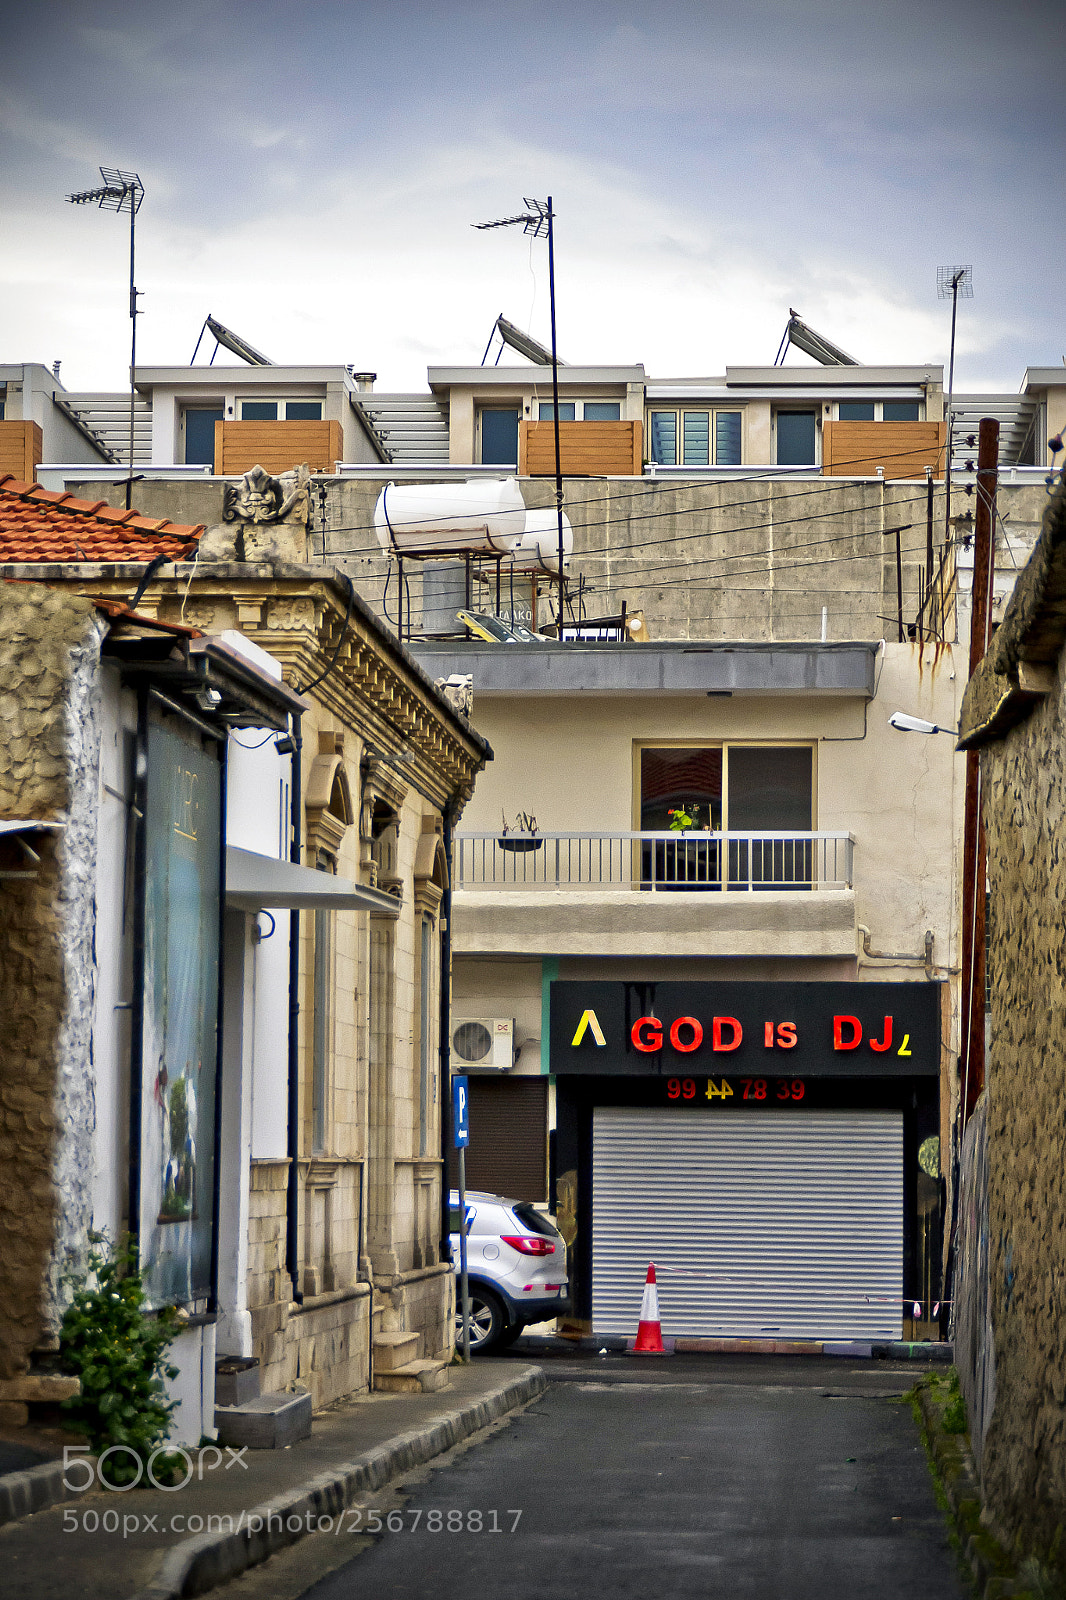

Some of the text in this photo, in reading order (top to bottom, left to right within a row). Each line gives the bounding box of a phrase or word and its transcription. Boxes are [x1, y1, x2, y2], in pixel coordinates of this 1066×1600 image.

[631, 1016, 743, 1052] GOD
[765, 1021, 798, 1048] IS
[459, 1086, 466, 1123] P
[667, 1078, 696, 1099] 99
[740, 1079, 767, 1100] 78
[776, 1079, 805, 1100] 39
